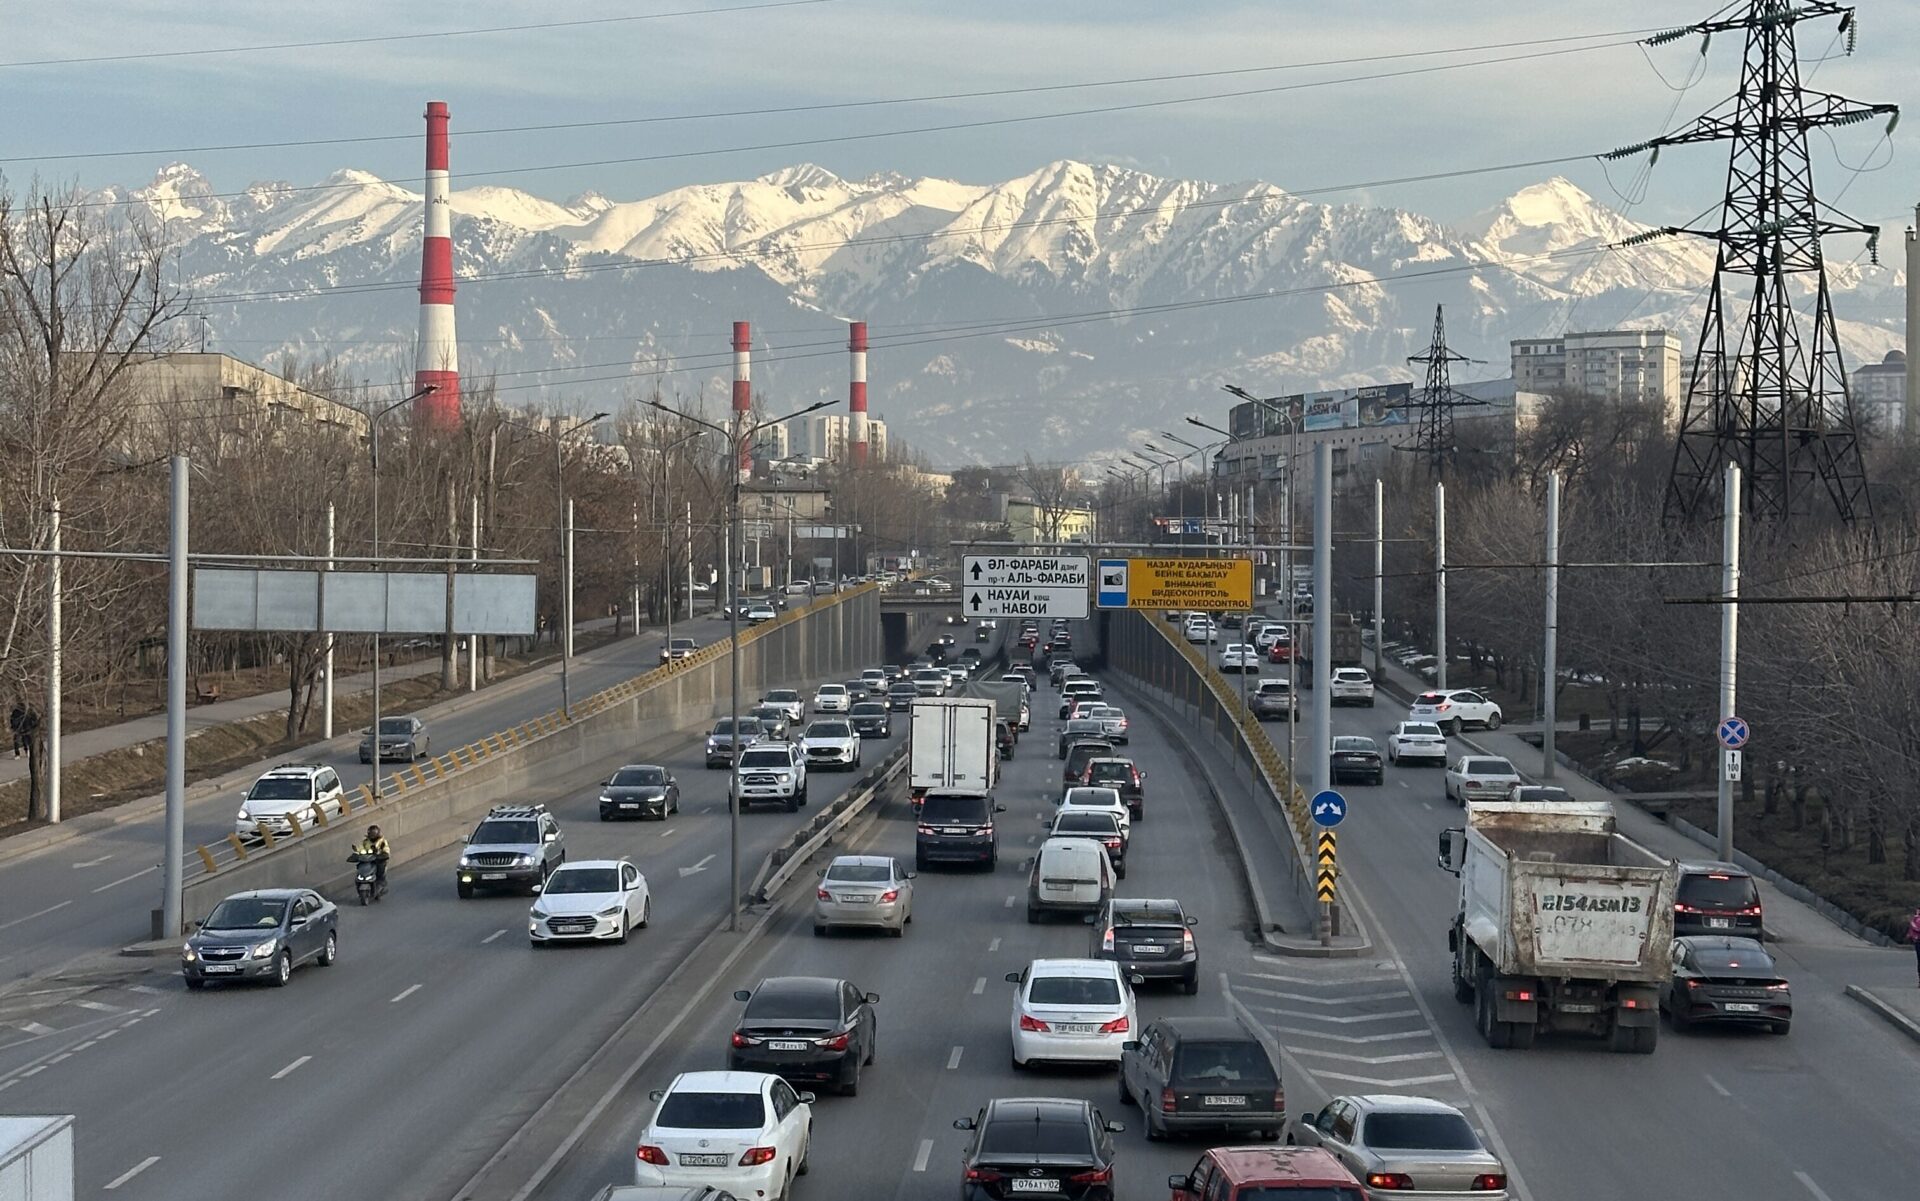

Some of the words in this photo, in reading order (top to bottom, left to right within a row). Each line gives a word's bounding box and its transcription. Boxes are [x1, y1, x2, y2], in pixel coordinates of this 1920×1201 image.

[988, 559, 1058, 570] ӘЛ-ФАРАБИ
[1147, 561, 1175, 569] НАЗАР
[1177, 561, 1236, 570] АУДАРЫҢЫЗ!
[988, 576, 1005, 584] пр-т
[1007, 572, 1085, 584] АЛЬ-ФАРАБИ
[1154, 570, 1184, 578] БЕЙНЕ
[1165, 580, 1216, 588] ВНИМАНИЕ!
[988, 589, 1030, 601] НАУАИ
[1152, 589, 1229, 598] ВИДЕОКОНТРОЛЬ
[1131, 599, 1181, 607] ATTENTION!
[1184, 599, 1249, 608] VIDEOCONTROL
[1002, 603, 1047, 614] НАВОИ
[1727, 764, 1740, 772] 100
